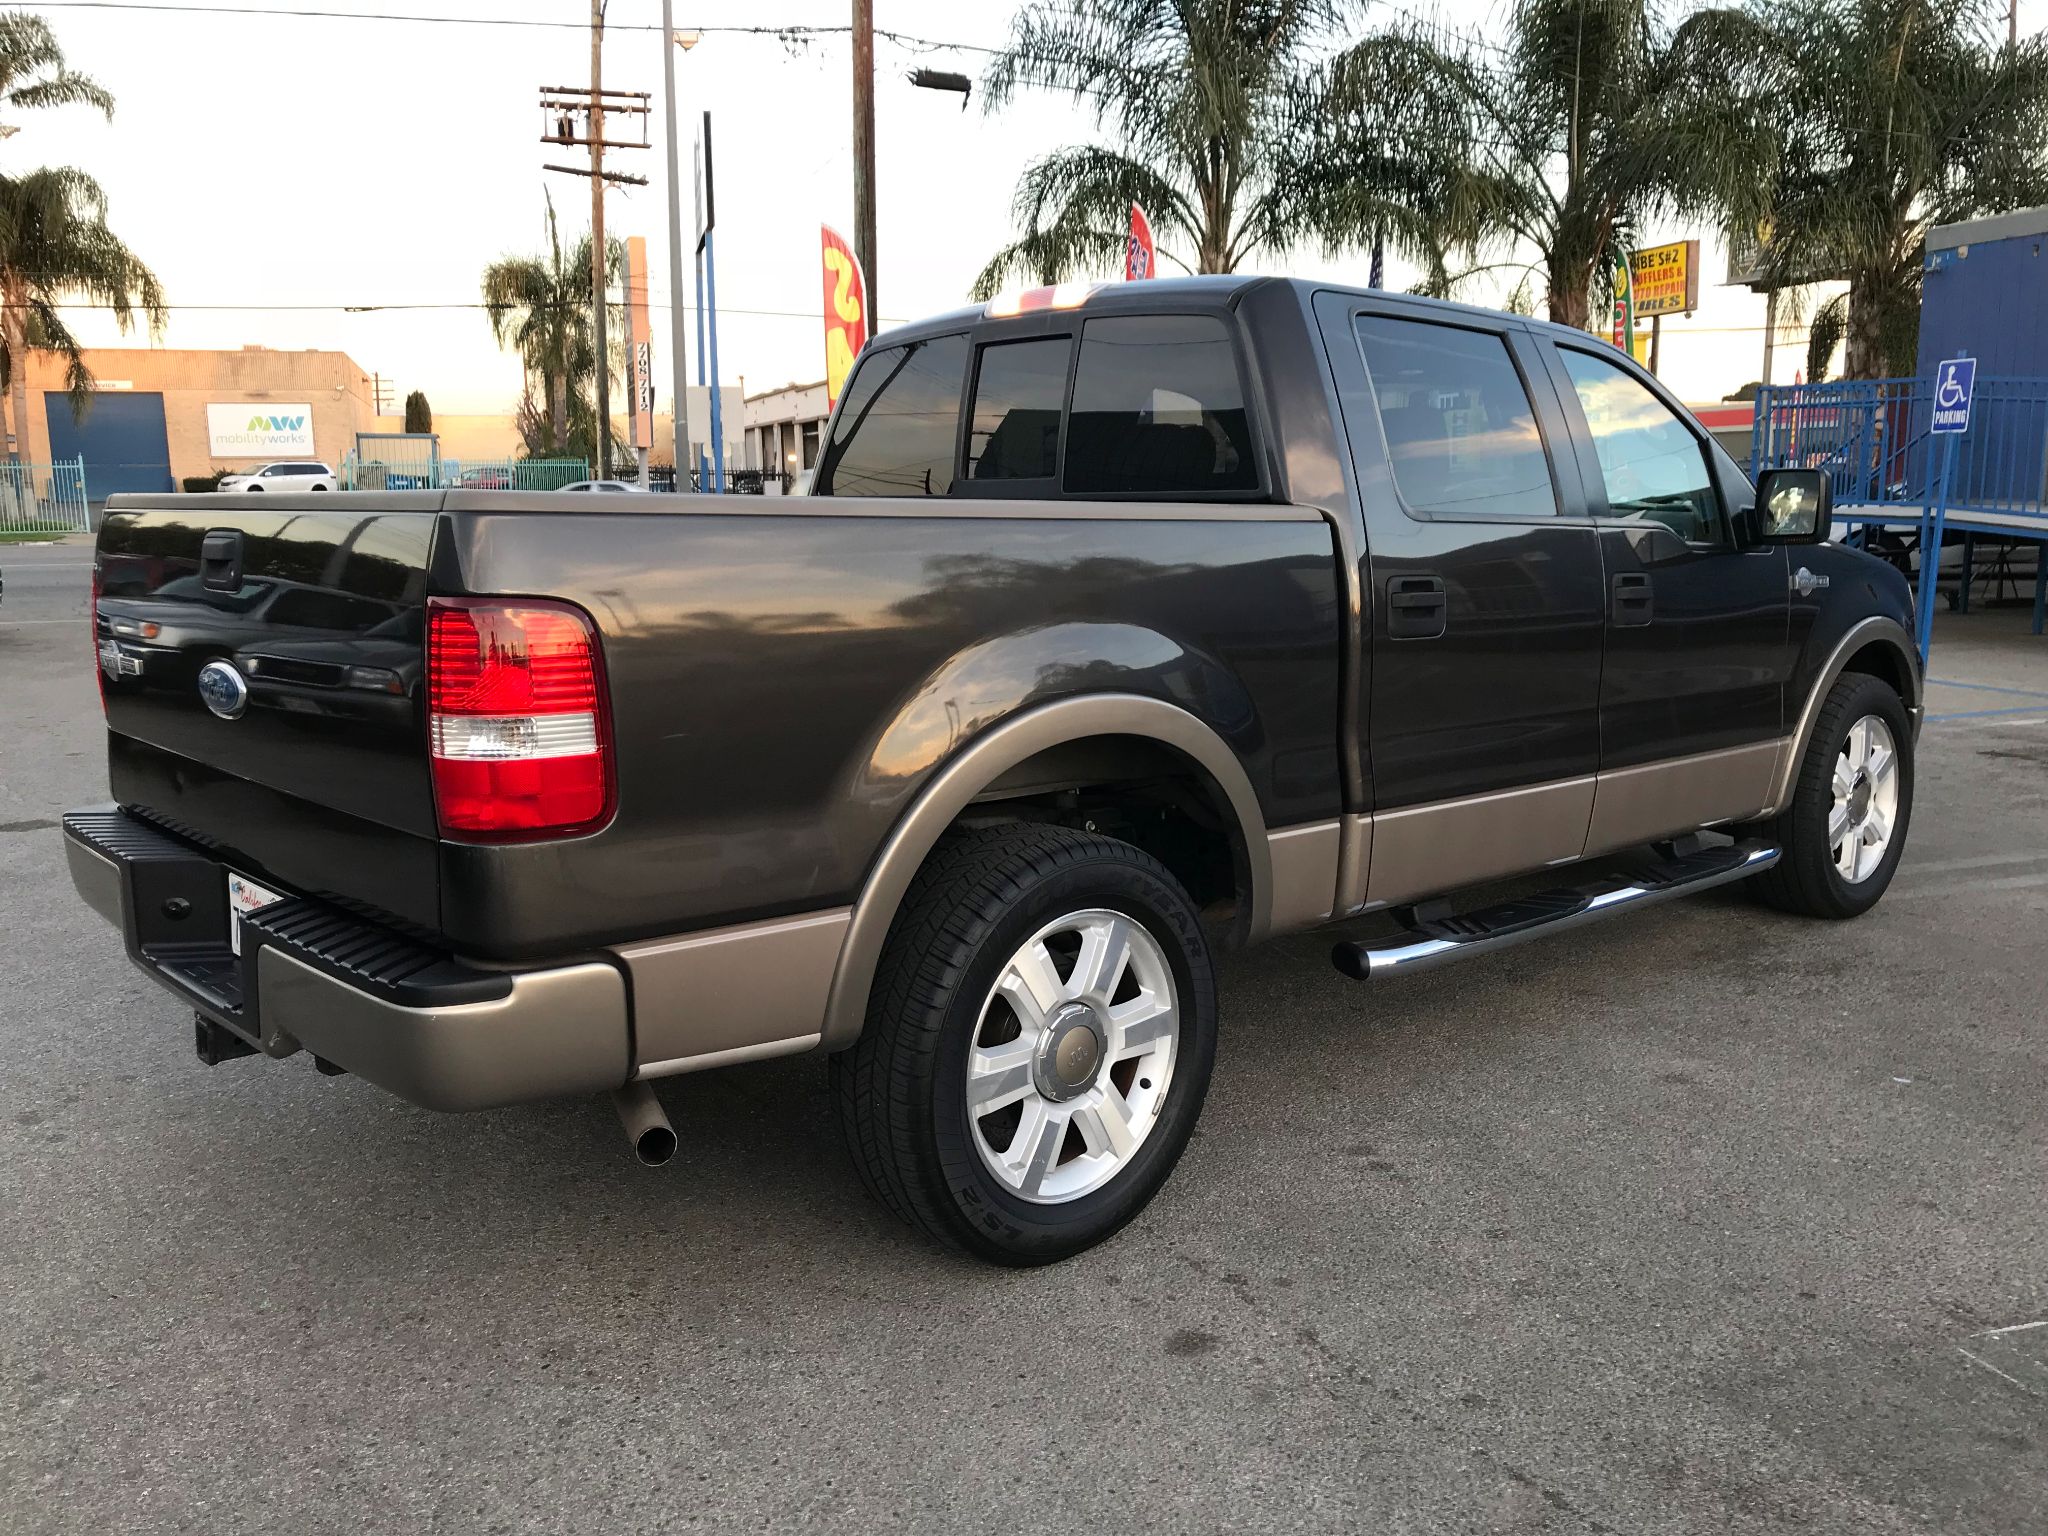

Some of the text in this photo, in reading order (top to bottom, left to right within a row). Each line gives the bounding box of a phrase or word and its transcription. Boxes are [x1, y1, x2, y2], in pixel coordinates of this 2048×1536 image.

[1633, 287, 1651, 300] UTO
[1935, 409, 1967, 425] PARKING
[216, 433, 304, 446] mobilityworks
